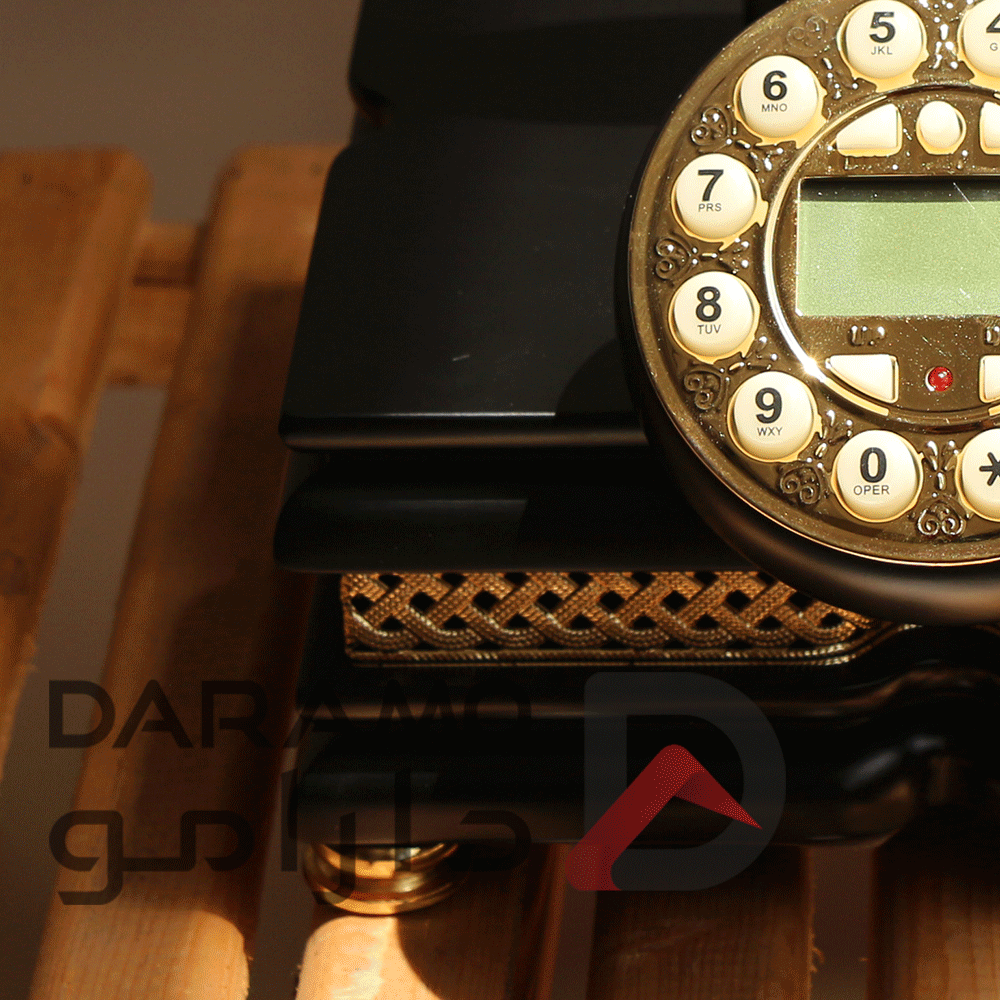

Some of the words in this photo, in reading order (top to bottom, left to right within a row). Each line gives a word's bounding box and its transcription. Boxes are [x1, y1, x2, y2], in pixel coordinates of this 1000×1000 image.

[869, 11, 896, 44] 5
[870, 45, 893, 56] JKL
[762, 70, 788, 101] 6
[761, 102, 788, 113] MNO
[697, 169, 724, 202] 7
[698, 202, 722, 213] PRS
[695, 286, 722, 323] 8
[696, 324, 722, 335] TUV
[755, 387, 783, 424] 9
[756, 426, 783, 437] WXY
[859, 447, 887, 484] 0
[853, 484, 890, 496] OPER
